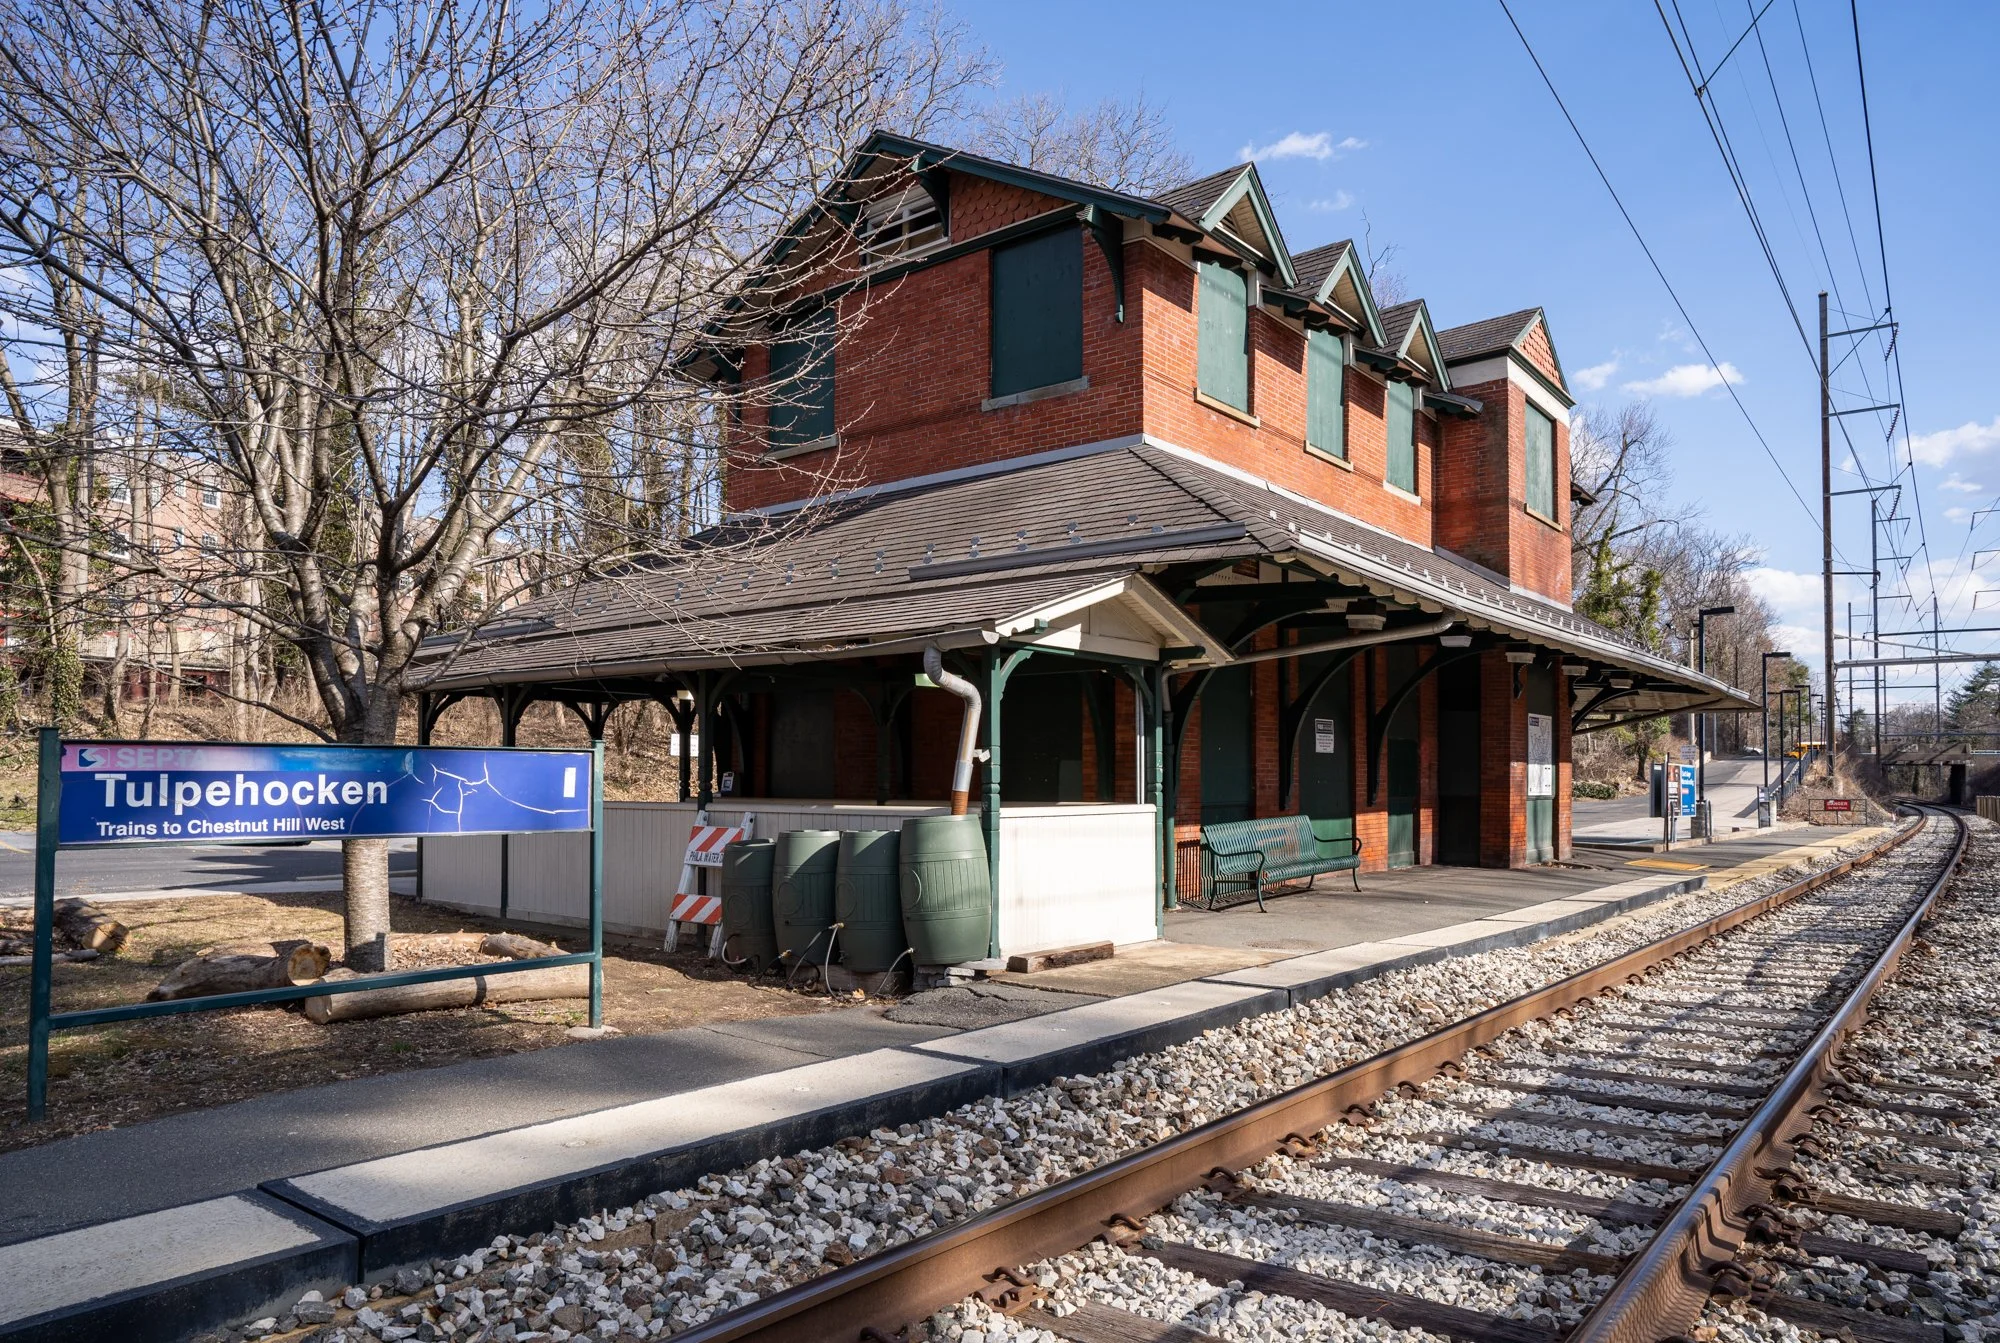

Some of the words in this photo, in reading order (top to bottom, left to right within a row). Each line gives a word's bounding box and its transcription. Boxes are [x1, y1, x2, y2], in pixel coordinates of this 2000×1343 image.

[115, 748, 206, 768] SEPTA
[94, 773, 387, 815] Tulpehocken
[96, 821, 157, 836] Trains
[162, 821, 182, 835] to
[187, 819, 268, 835] Chestnut
[273, 817, 300, 832] Hill
[305, 817, 345, 831] West
